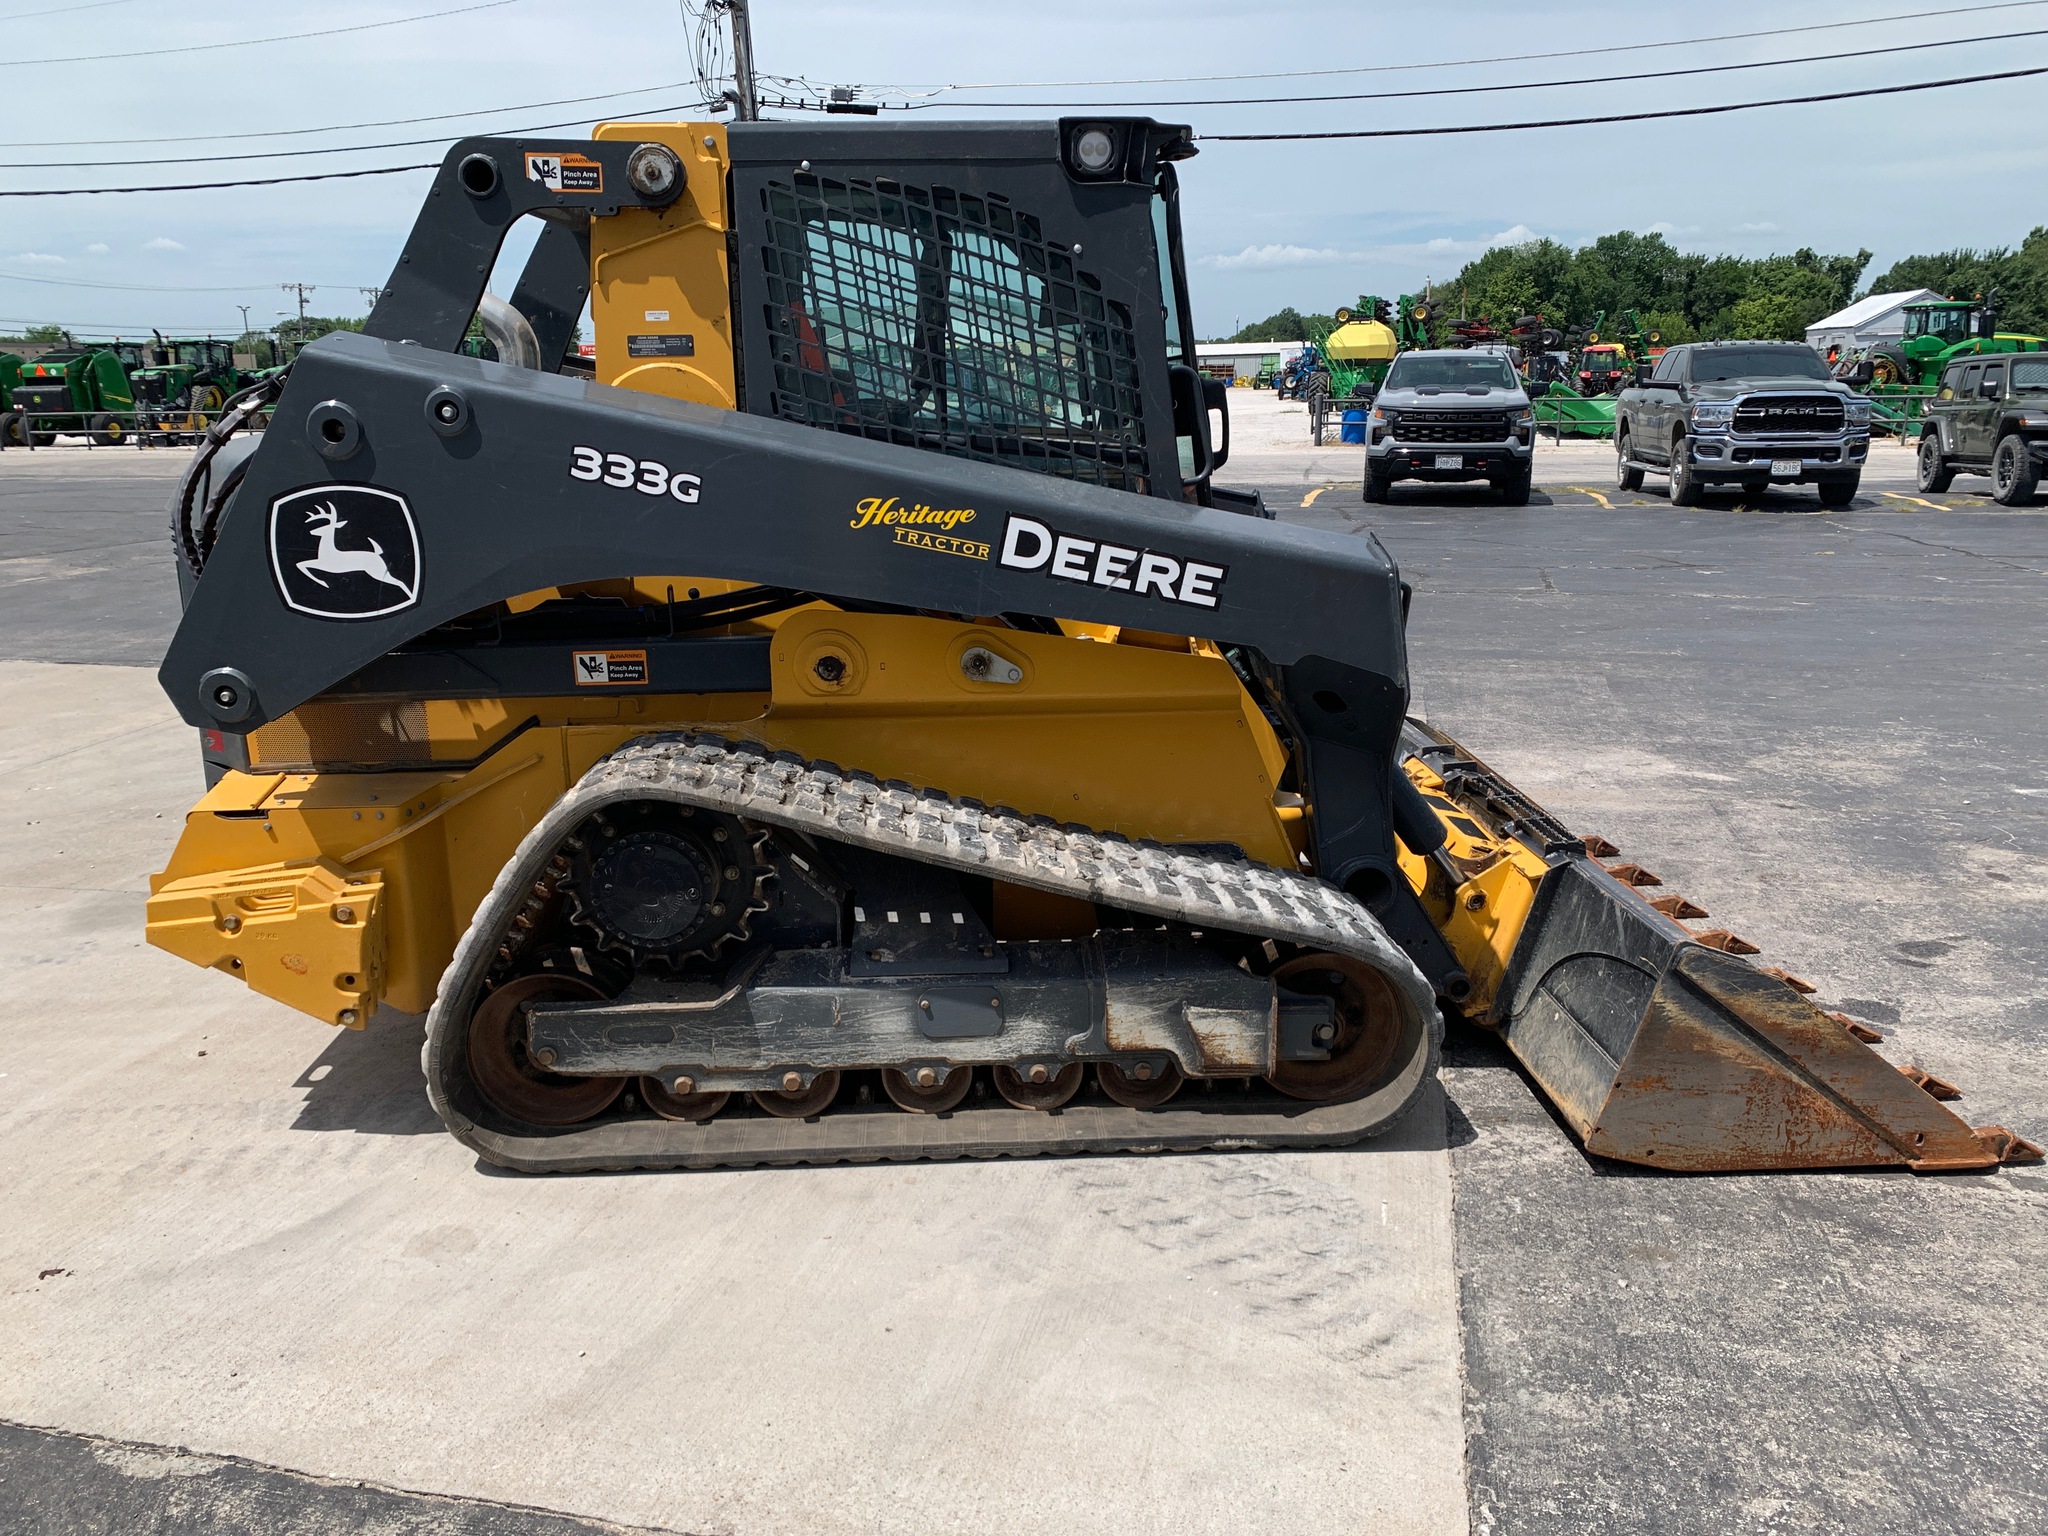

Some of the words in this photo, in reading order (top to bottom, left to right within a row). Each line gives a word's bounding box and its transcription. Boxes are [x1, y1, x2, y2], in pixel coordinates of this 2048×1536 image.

[570, 446, 701, 504] 333G
[849, 496, 977, 530] Heritage
[894, 529, 990, 558] TRACTOR
[1000, 516, 1224, 607] DEERE
